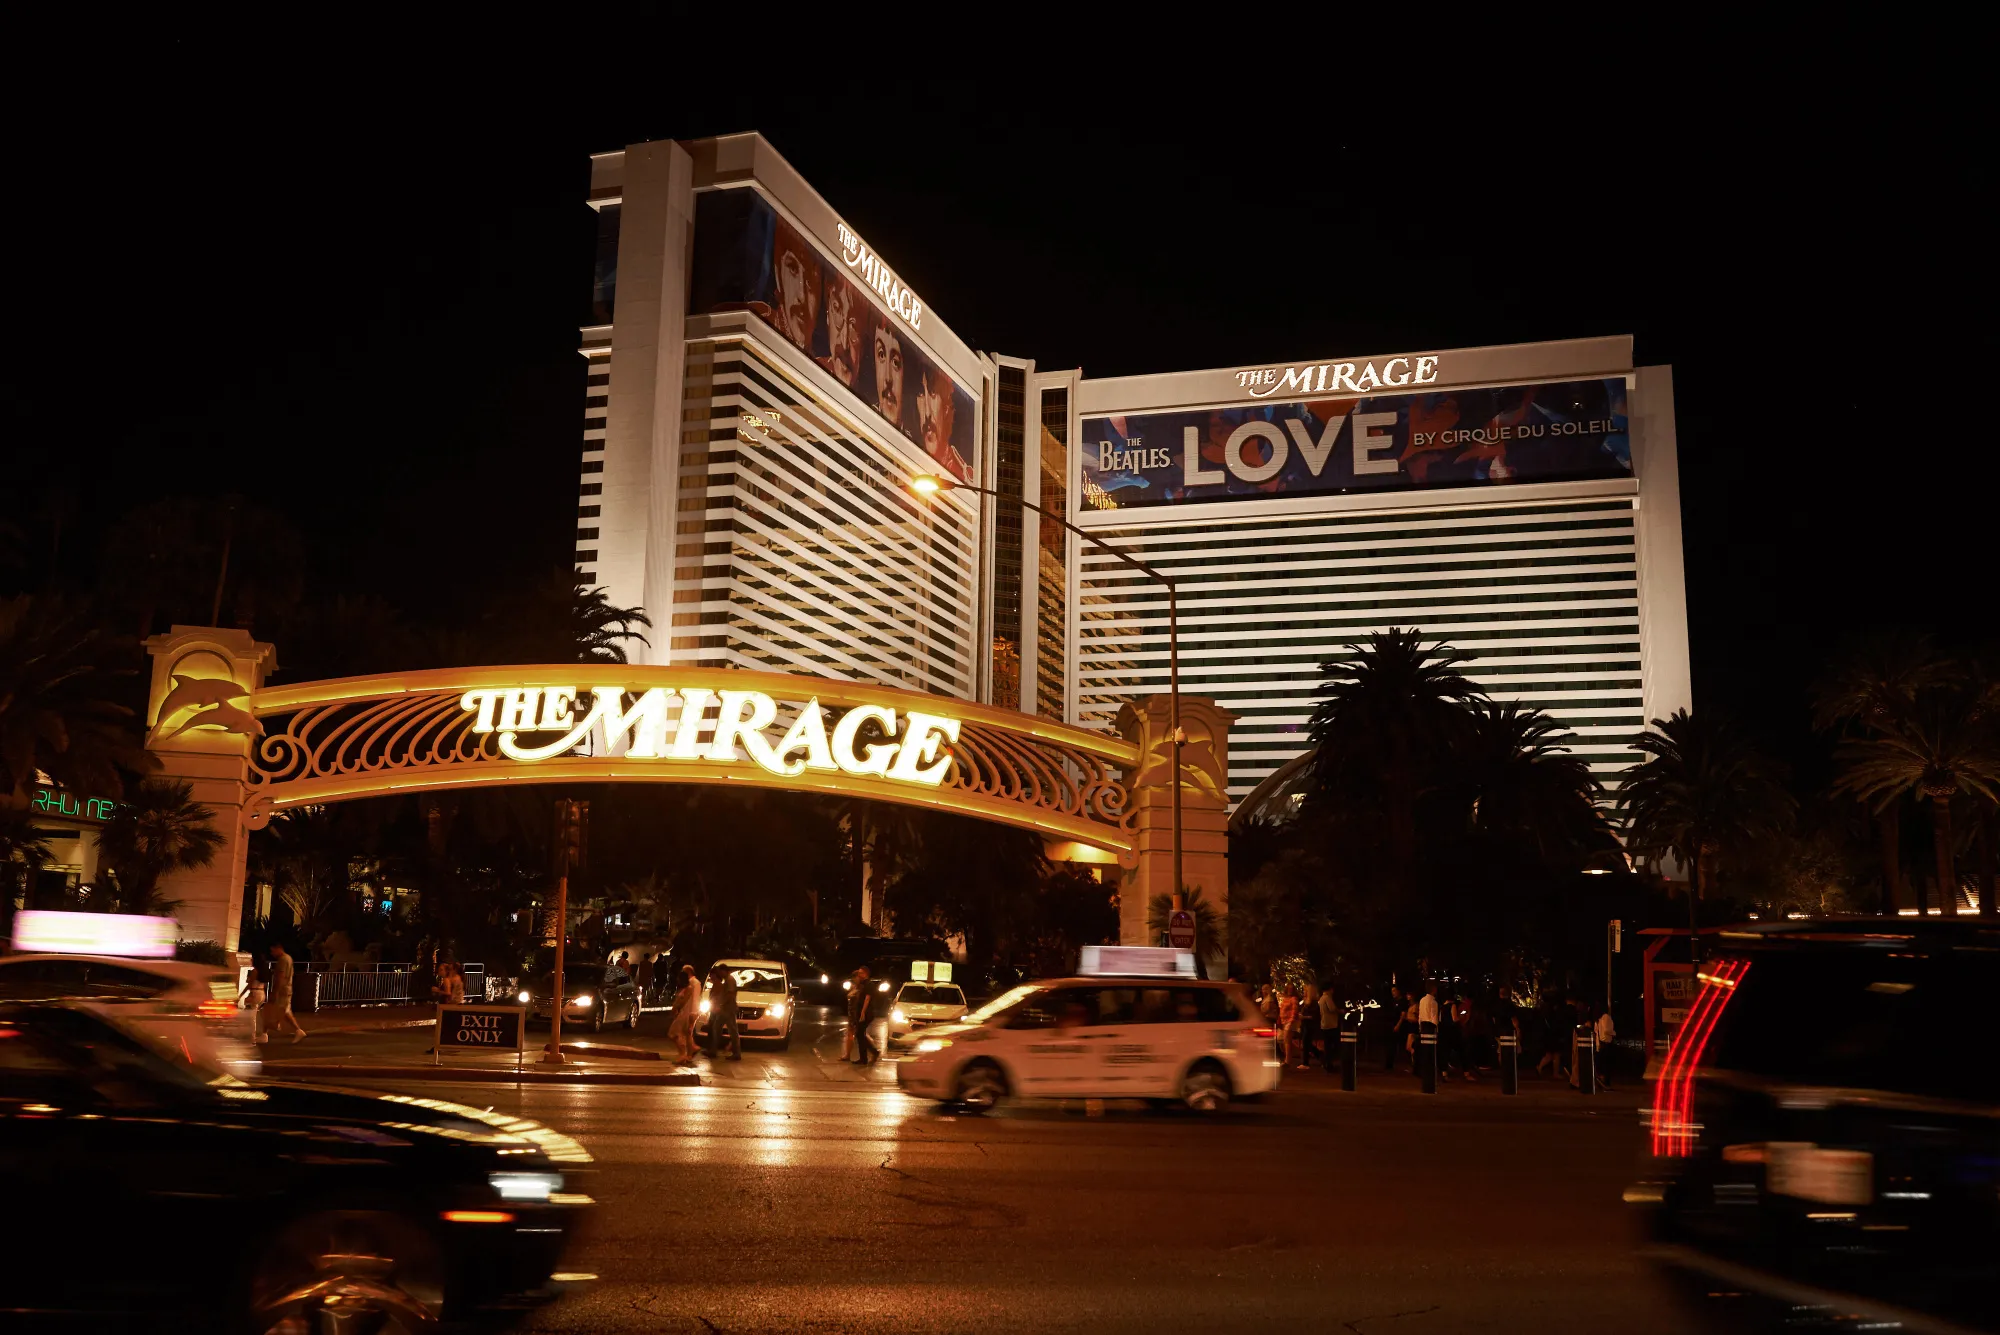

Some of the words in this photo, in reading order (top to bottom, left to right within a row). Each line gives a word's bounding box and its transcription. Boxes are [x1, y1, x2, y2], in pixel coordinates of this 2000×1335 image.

[837, 223, 858, 256] THE
[843, 244, 922, 330] MIRAGE
[1235, 368, 1276, 387] THE
[1249, 355, 1439, 397] MIRAGE
[1126, 437, 1142, 447] THE
[1183, 411, 1399, 486] LOVE
[1413, 431, 1436, 446] BY
[1441, 426, 1512, 445] CIRQUE
[1517, 424, 1545, 439] DU
[1551, 419, 1618, 436] SOLEIL
[1099, 440, 1170, 475] BEATLES
[460, 686, 577, 733] THE
[498, 686, 962, 787] MIRAGE
[456, 1029, 503, 1043] ONLY
[461, 1015, 501, 1028] EXIT
